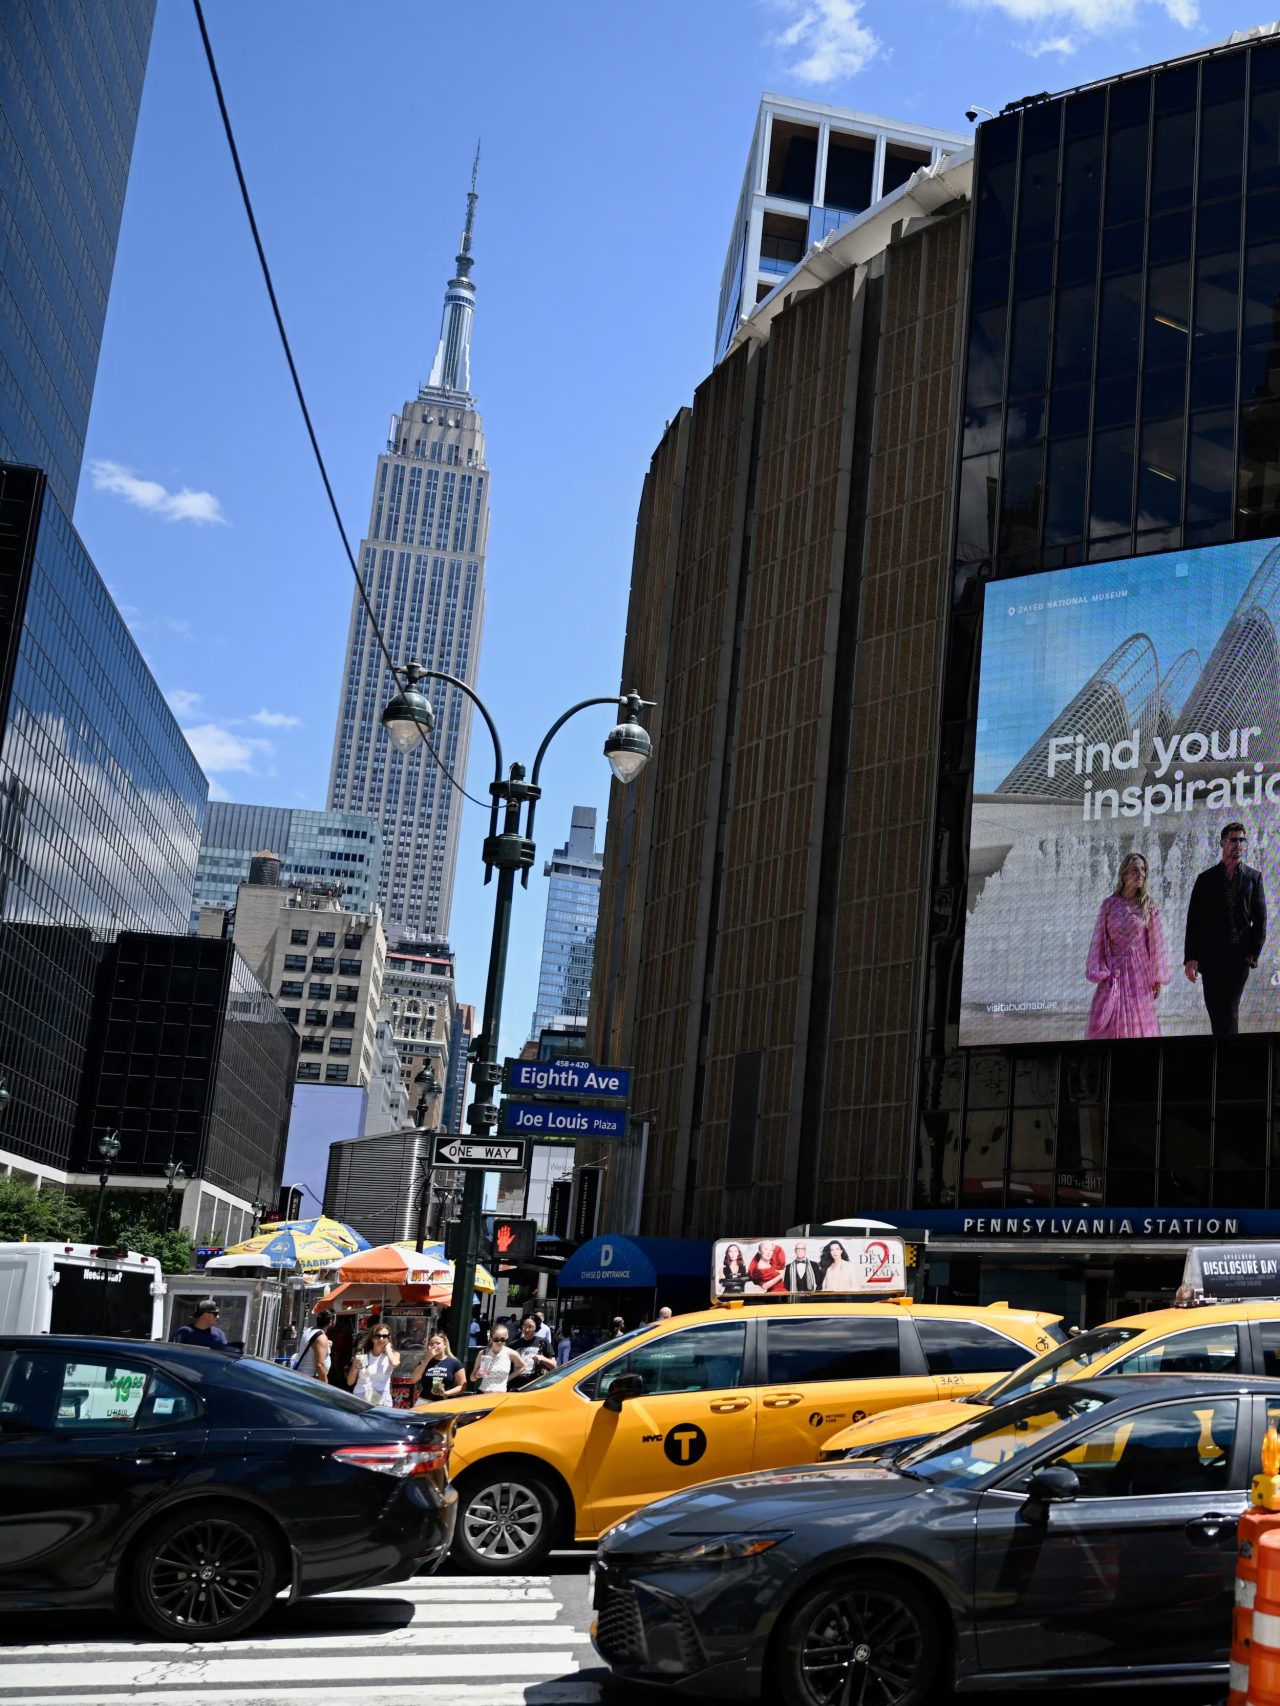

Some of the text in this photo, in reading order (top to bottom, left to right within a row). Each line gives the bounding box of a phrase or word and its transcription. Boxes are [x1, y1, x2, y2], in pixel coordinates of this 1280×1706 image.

[1018, 590, 1128, 614] ZAYED NATIONAL MUSEUM
[1047, 726, 1262, 779] Find your
[555, 1060, 590, 1069] 458 420
[520, 1067, 620, 1091] Eighth Ave
[516, 1110, 617, 1131] Joe Louis Plaza
[449, 1146, 512, 1159] ONE WAY
[963, 1218, 1239, 1234] PENNSYLVANIA STATION
[600, 1244, 613, 1267] D
[864, 1241, 895, 1283] 2
[83, 1268, 101, 1280] Need
[108, 1270, 123, 1283] Van?
[581, 1270, 631, 1279] CHASE ENTRANCE
[1202, 1259, 1278, 1276] DISCLOSURE DAY
[642, 1433, 663, 1444] NYC
[673, 1430, 698, 1461] T
